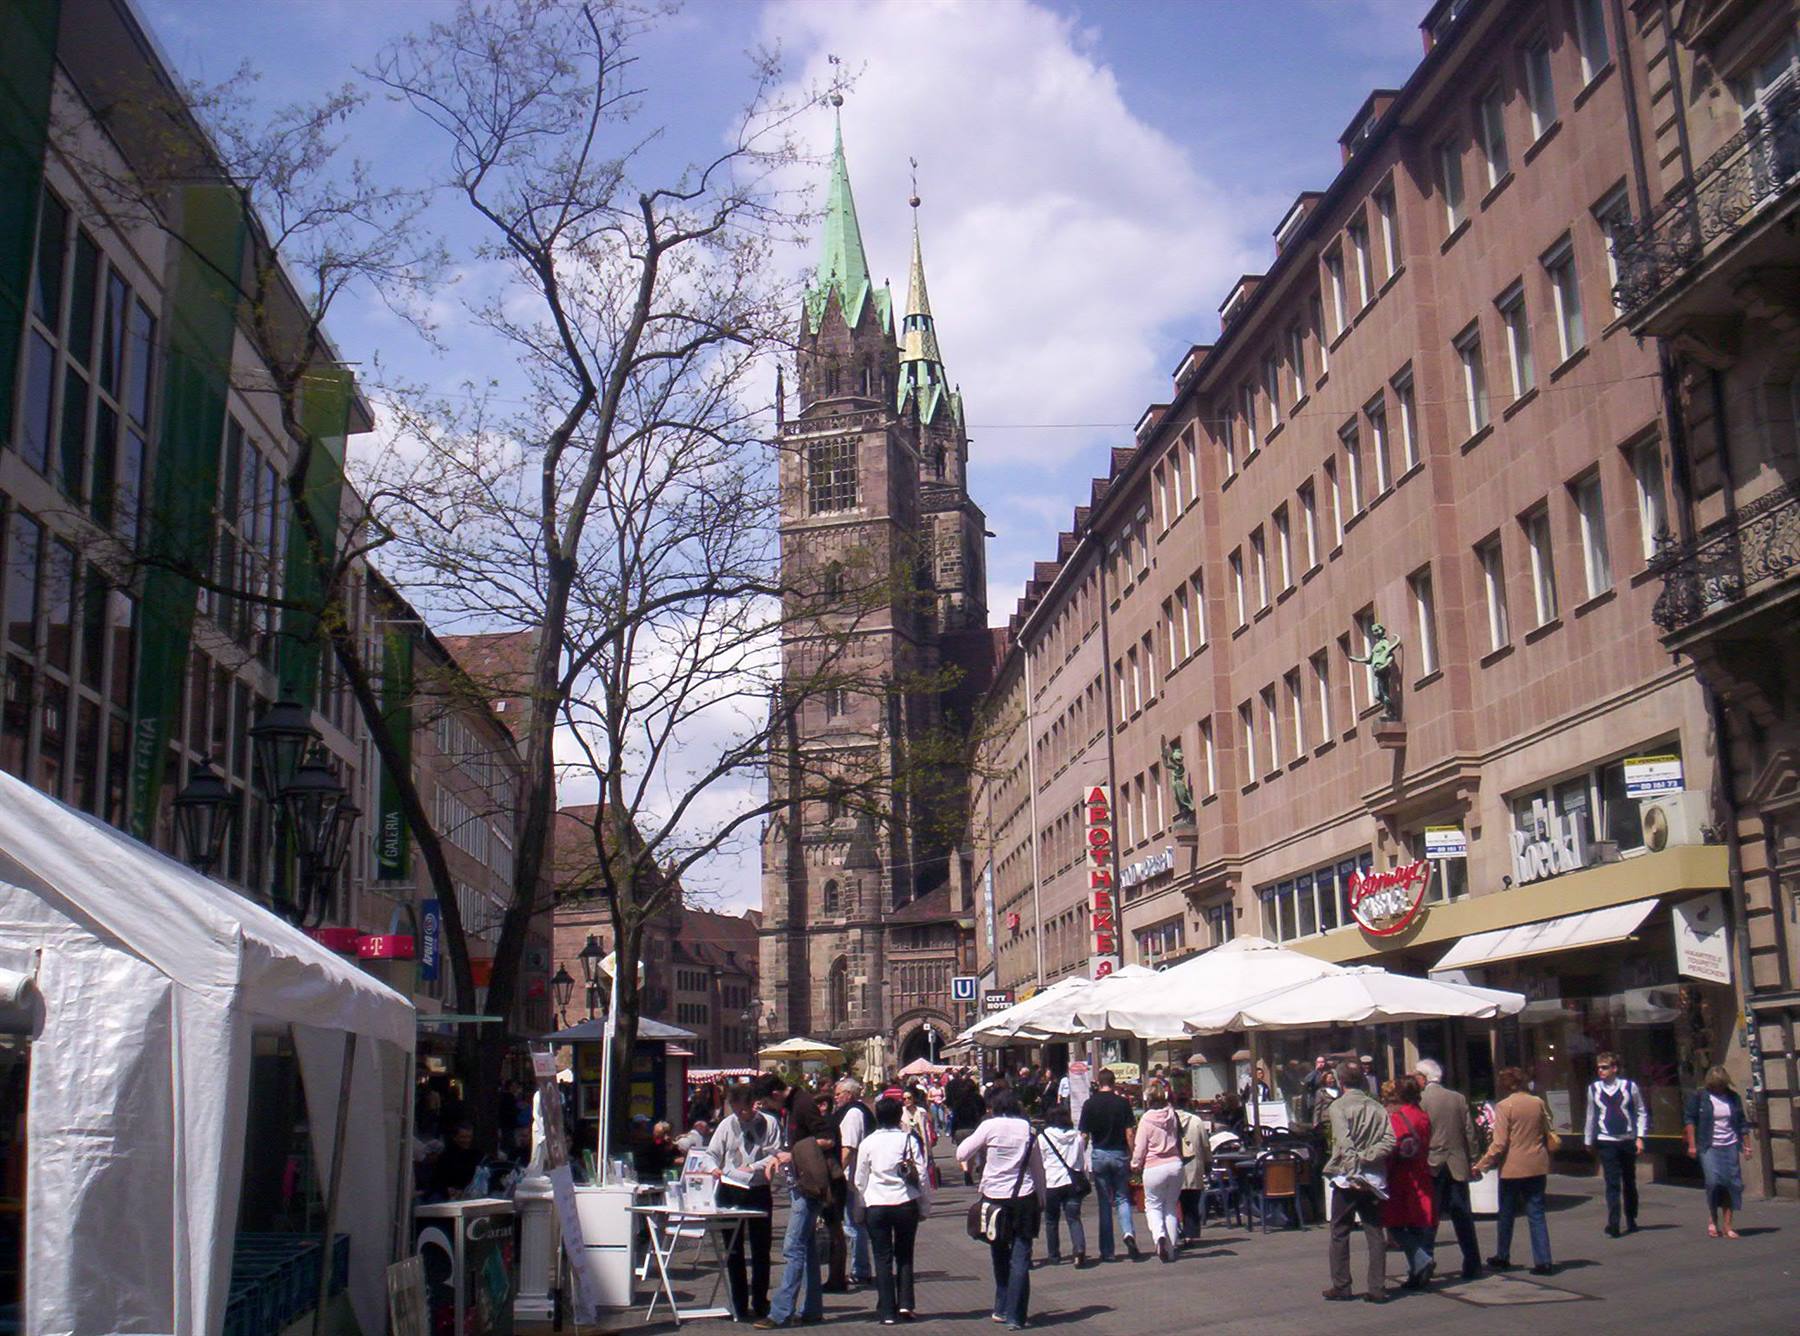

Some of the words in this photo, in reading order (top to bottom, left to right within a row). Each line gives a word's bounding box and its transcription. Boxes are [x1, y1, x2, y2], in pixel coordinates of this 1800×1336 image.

[384, 811, 399, 857] GALERIA
[1087, 787, 1115, 953] APOTHEKE
[422, 935, 434, 966] APOLLO
[957, 980, 971, 998] U
